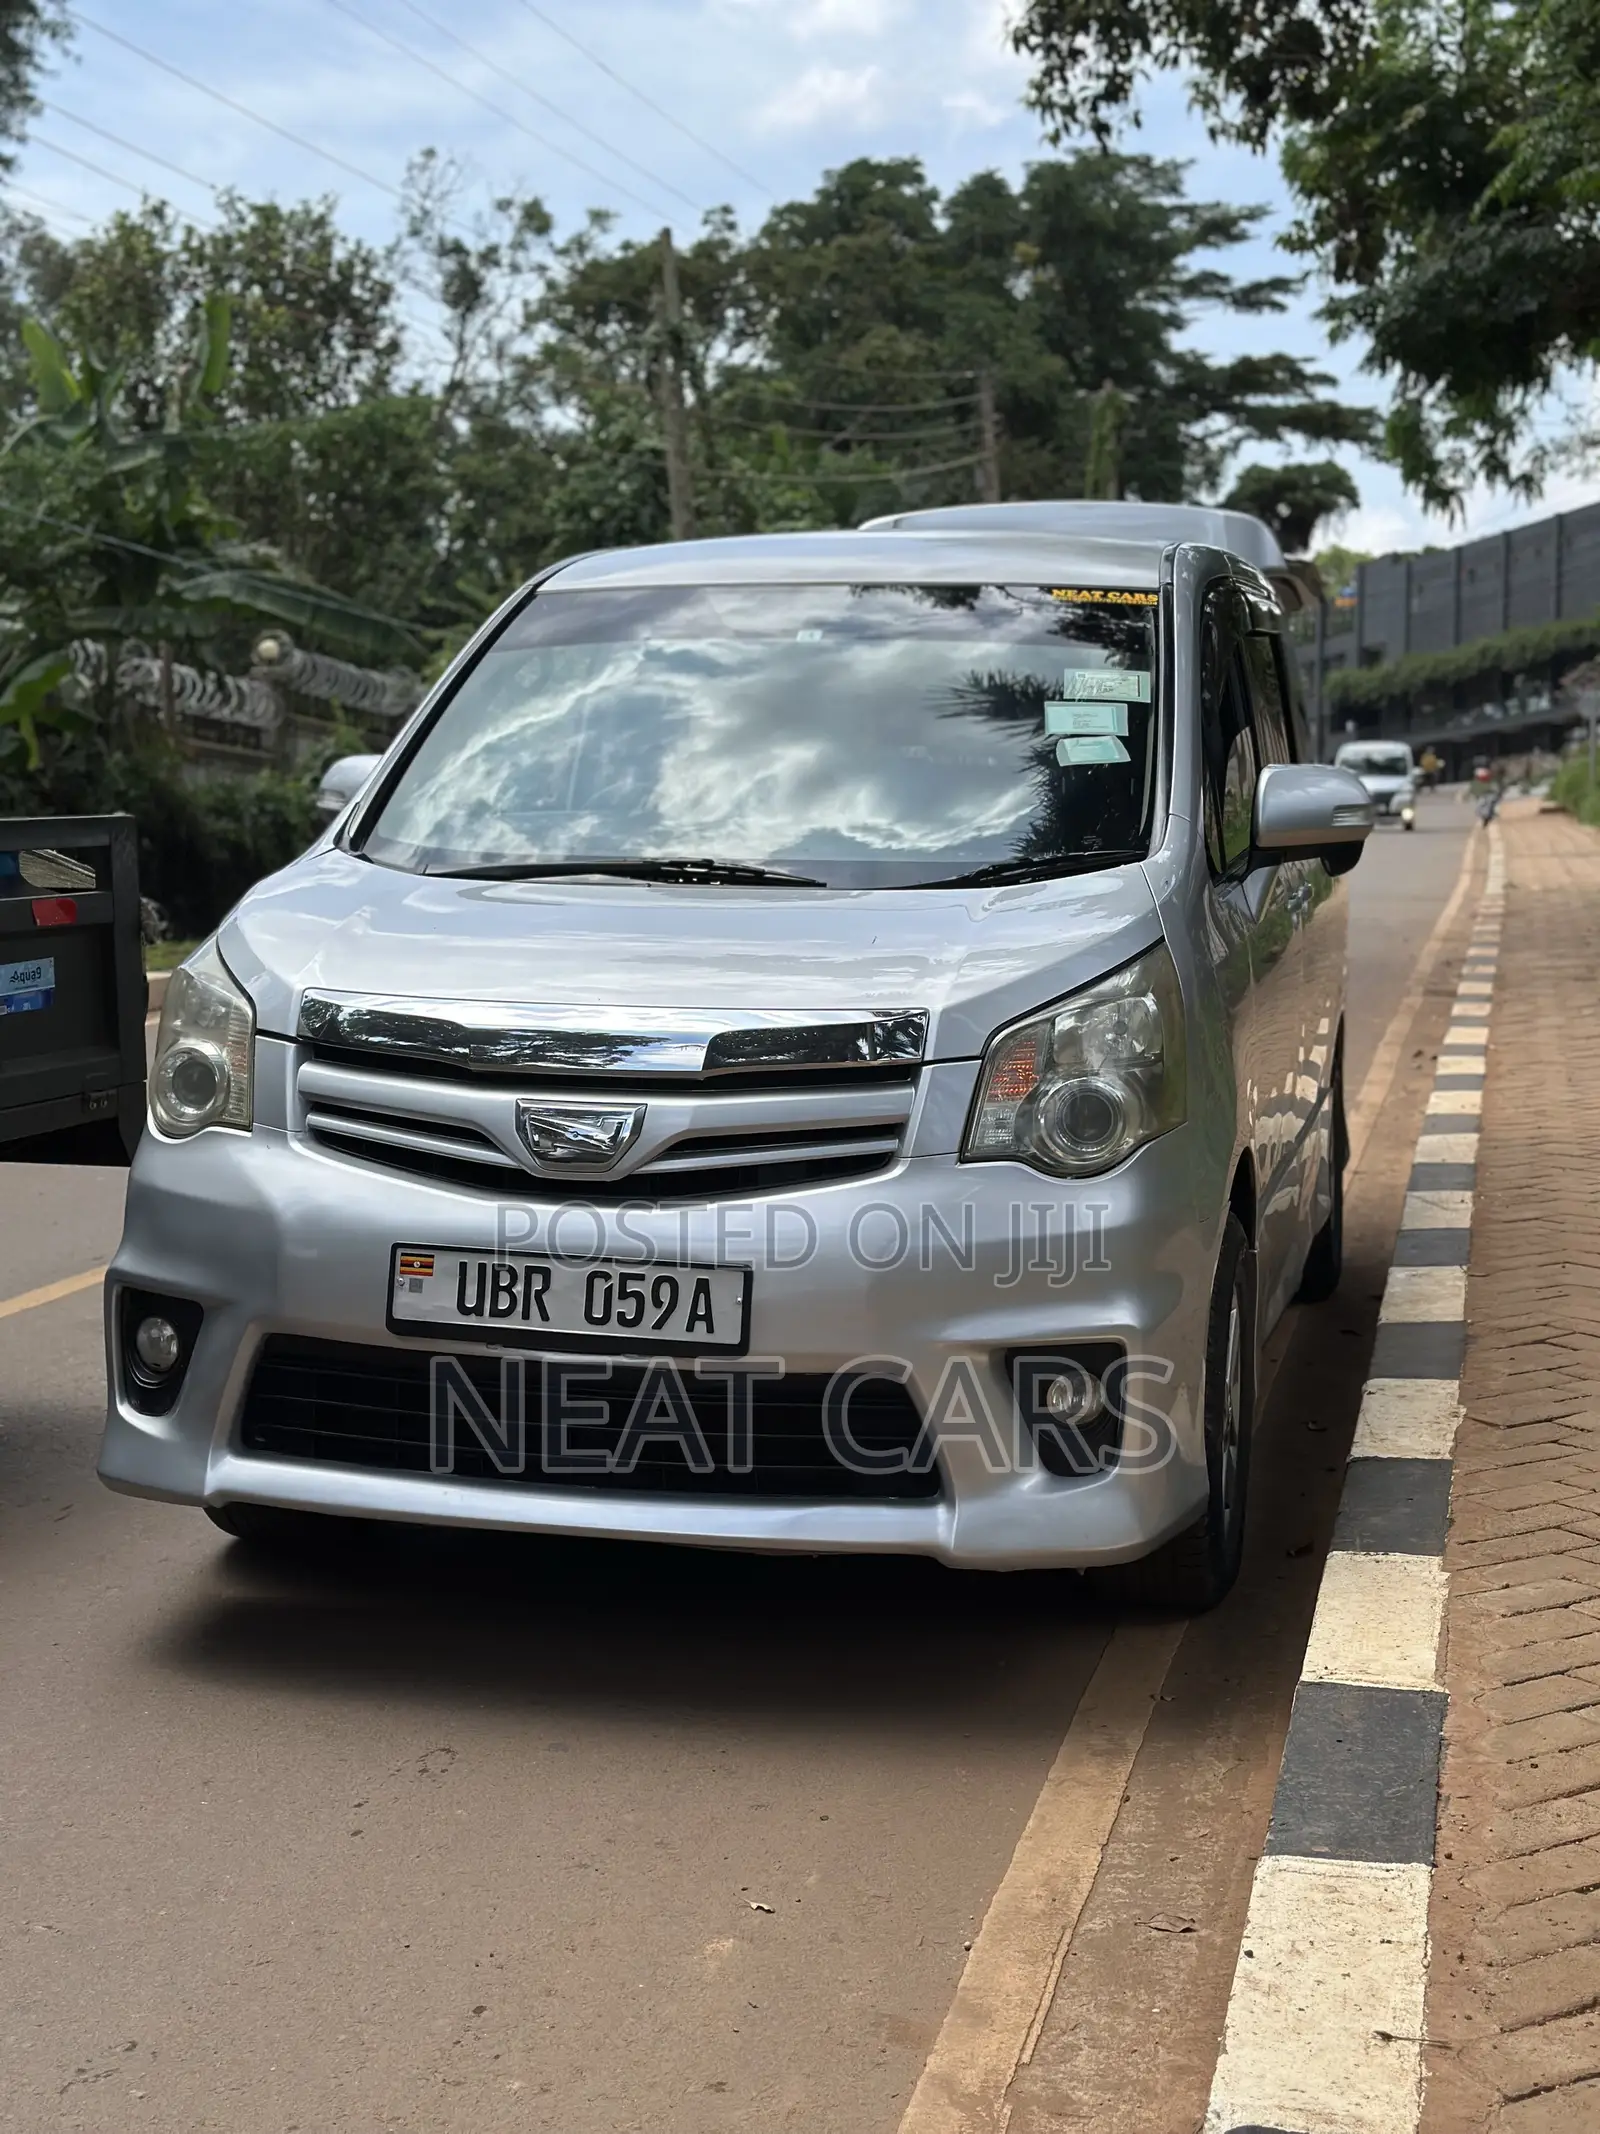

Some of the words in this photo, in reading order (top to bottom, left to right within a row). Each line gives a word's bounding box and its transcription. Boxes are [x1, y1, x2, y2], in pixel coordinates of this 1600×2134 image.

[1051, 588, 1104, 600] NEAT
[1107, 591, 1158, 602] CARS
[10, 966, 42, 984] Aqua9
[455, 1260, 552, 1322] UBR
[584, 1270, 715, 1334] 059A
